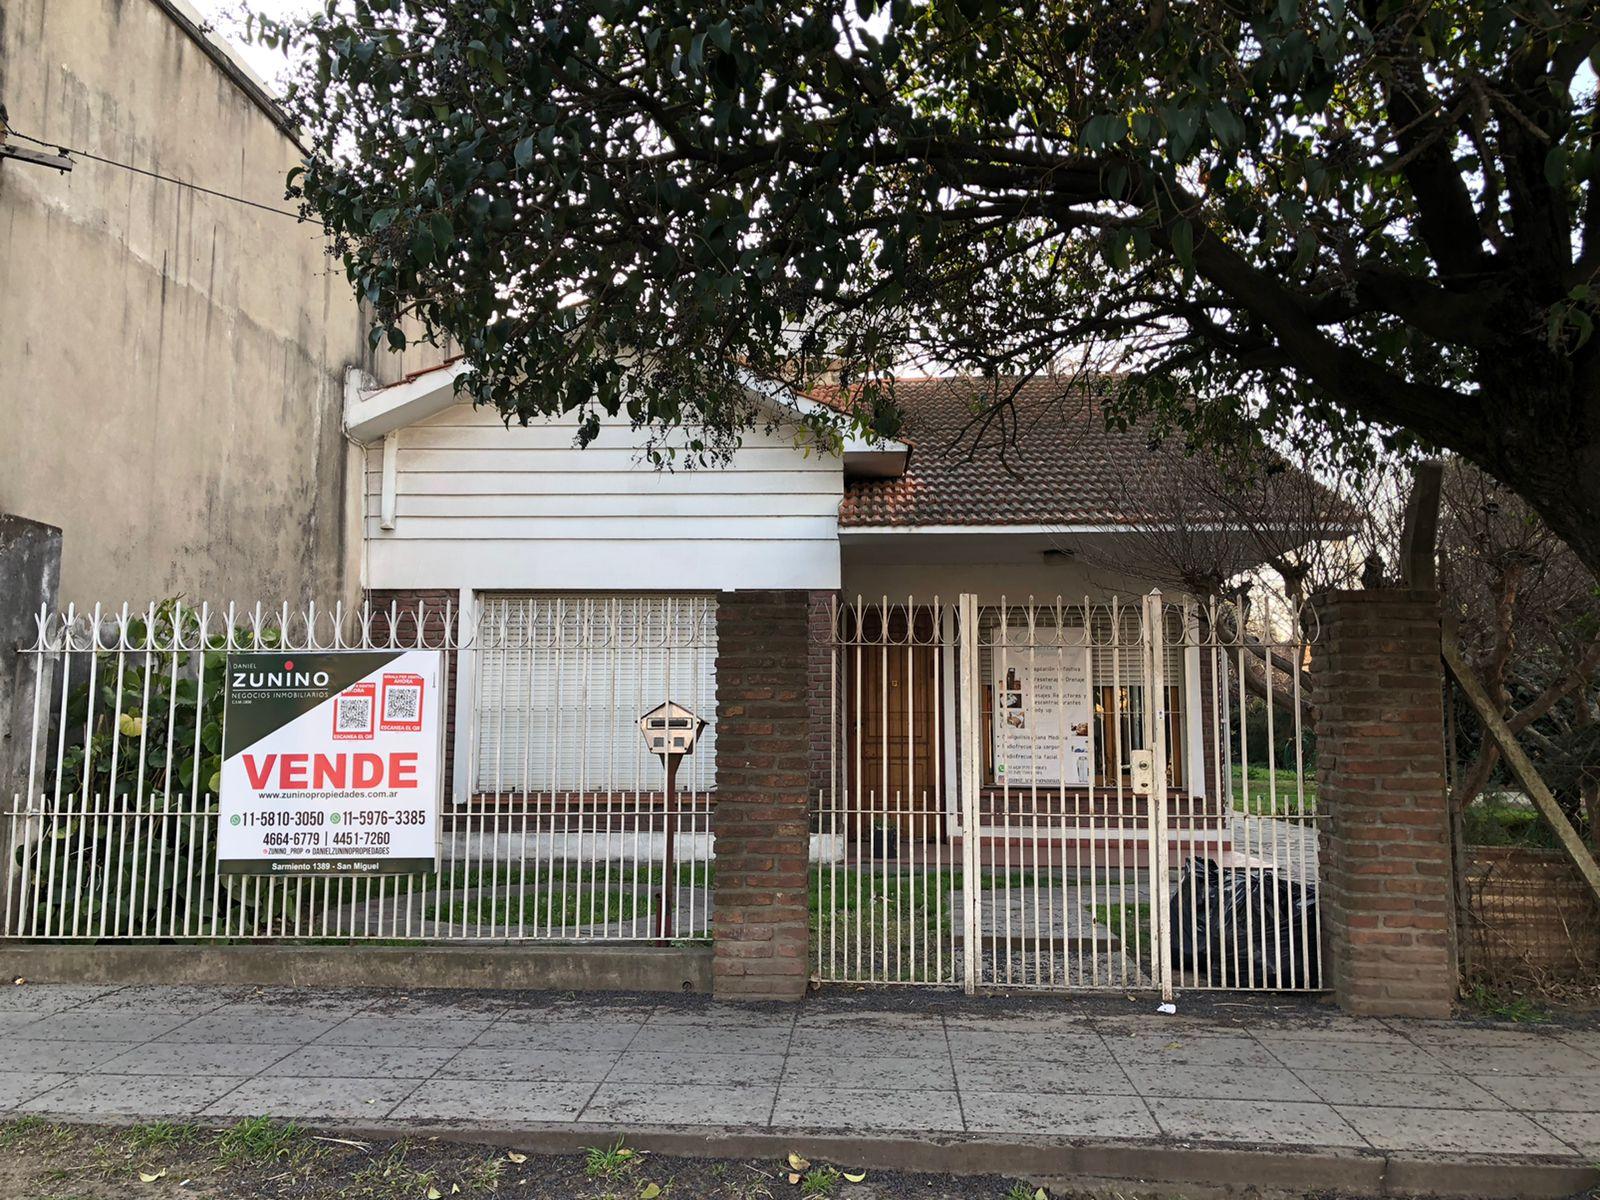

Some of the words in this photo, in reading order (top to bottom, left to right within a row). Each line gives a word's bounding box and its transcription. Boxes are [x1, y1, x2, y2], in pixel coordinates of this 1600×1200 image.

[232, 671, 330, 688] ZUNINO
[231, 691, 271, 700] NEGOCIOS
[272, 691, 329, 699] INMOBILIARIOS
[242, 752, 418, 790] VENDE
[258, 790, 398, 800] www.zuninopropiedades.com.ar
[242, 811, 325, 827] 11-5810-3050
[342, 810, 426, 826] 11-5976-3385
[262, 832, 320, 846] 4664-6779
[333, 831, 390, 845] 4451-7260
[312, 847, 390, 855] DANIELZUNINOPROPIEDADES
[271, 862, 311, 871] Sarmiento
[312, 862, 331, 870] 1389
[336, 862, 352, 870] San
[353, 862, 380, 872] Miguel
